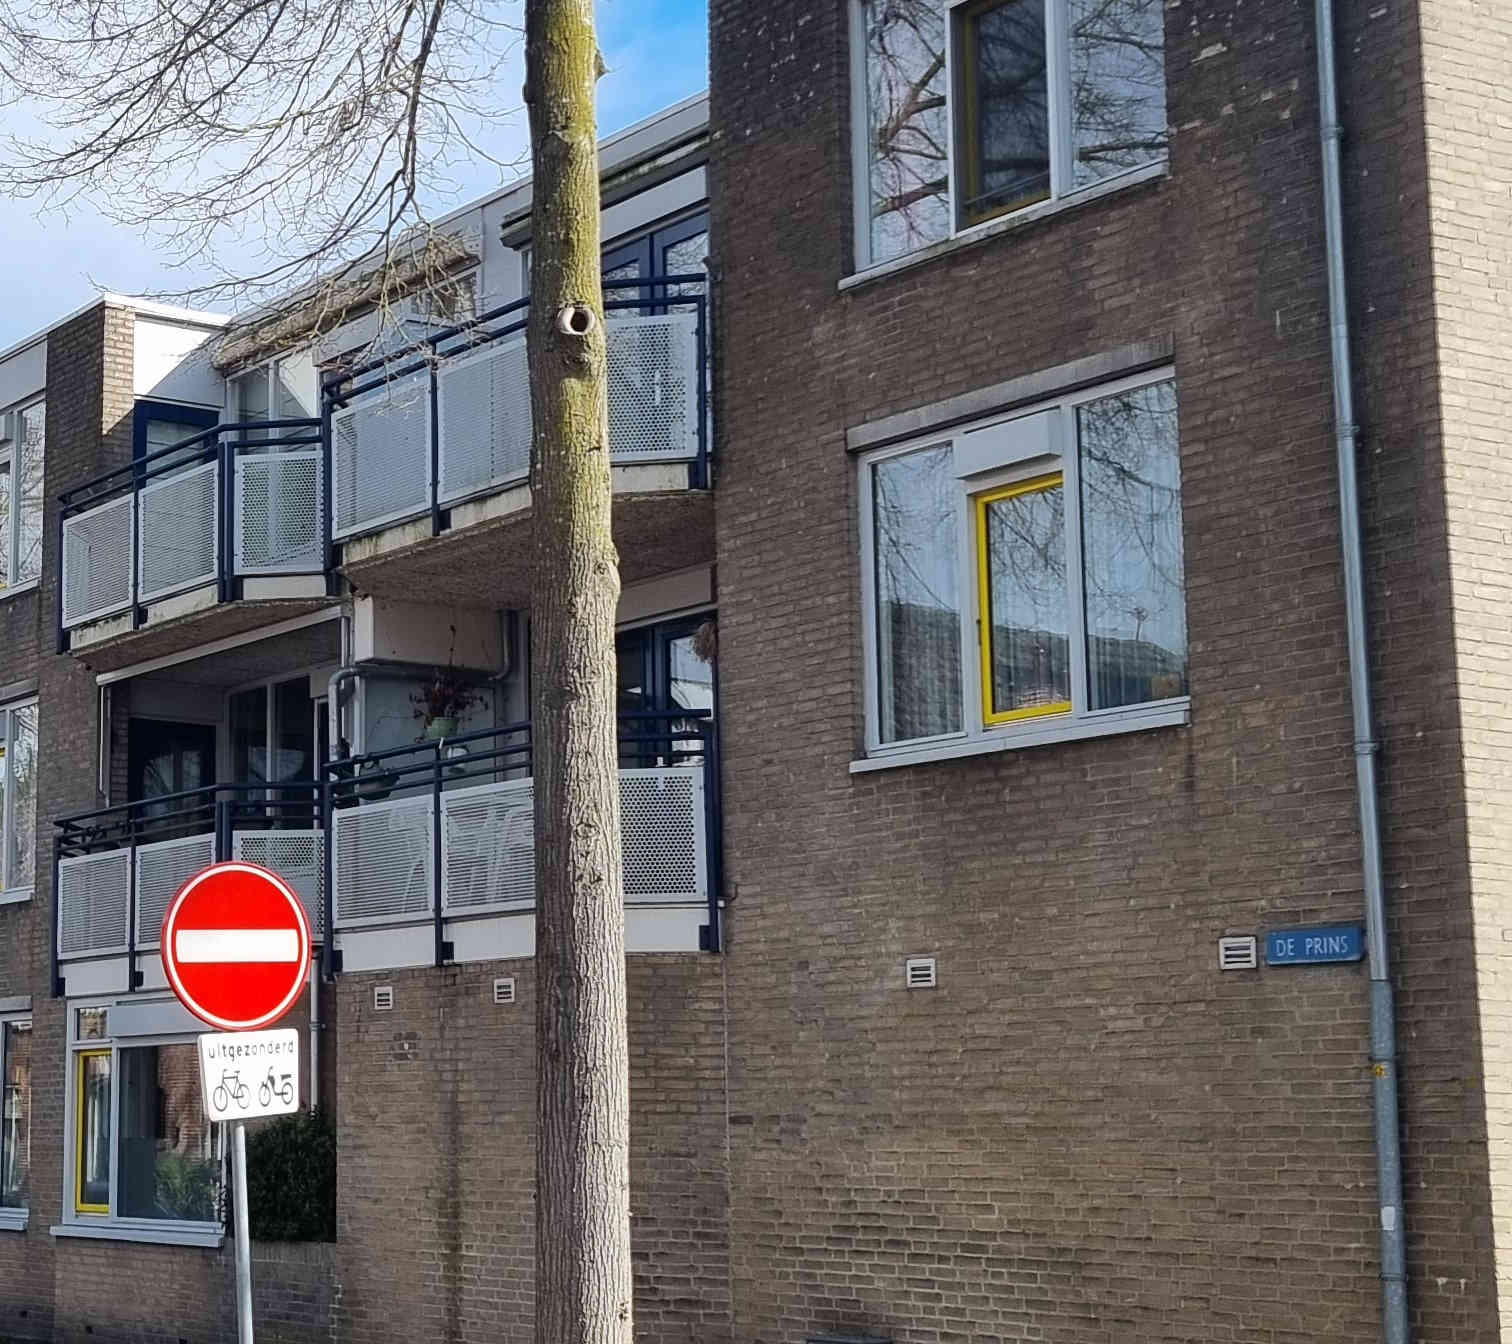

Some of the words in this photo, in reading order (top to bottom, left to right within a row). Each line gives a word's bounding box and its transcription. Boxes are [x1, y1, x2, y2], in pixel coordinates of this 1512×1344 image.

[1276, 938, 1295, 957] DE
[1305, 936, 1348, 956] PRINS
[208, 1040, 293, 1062] uitgezonderd
